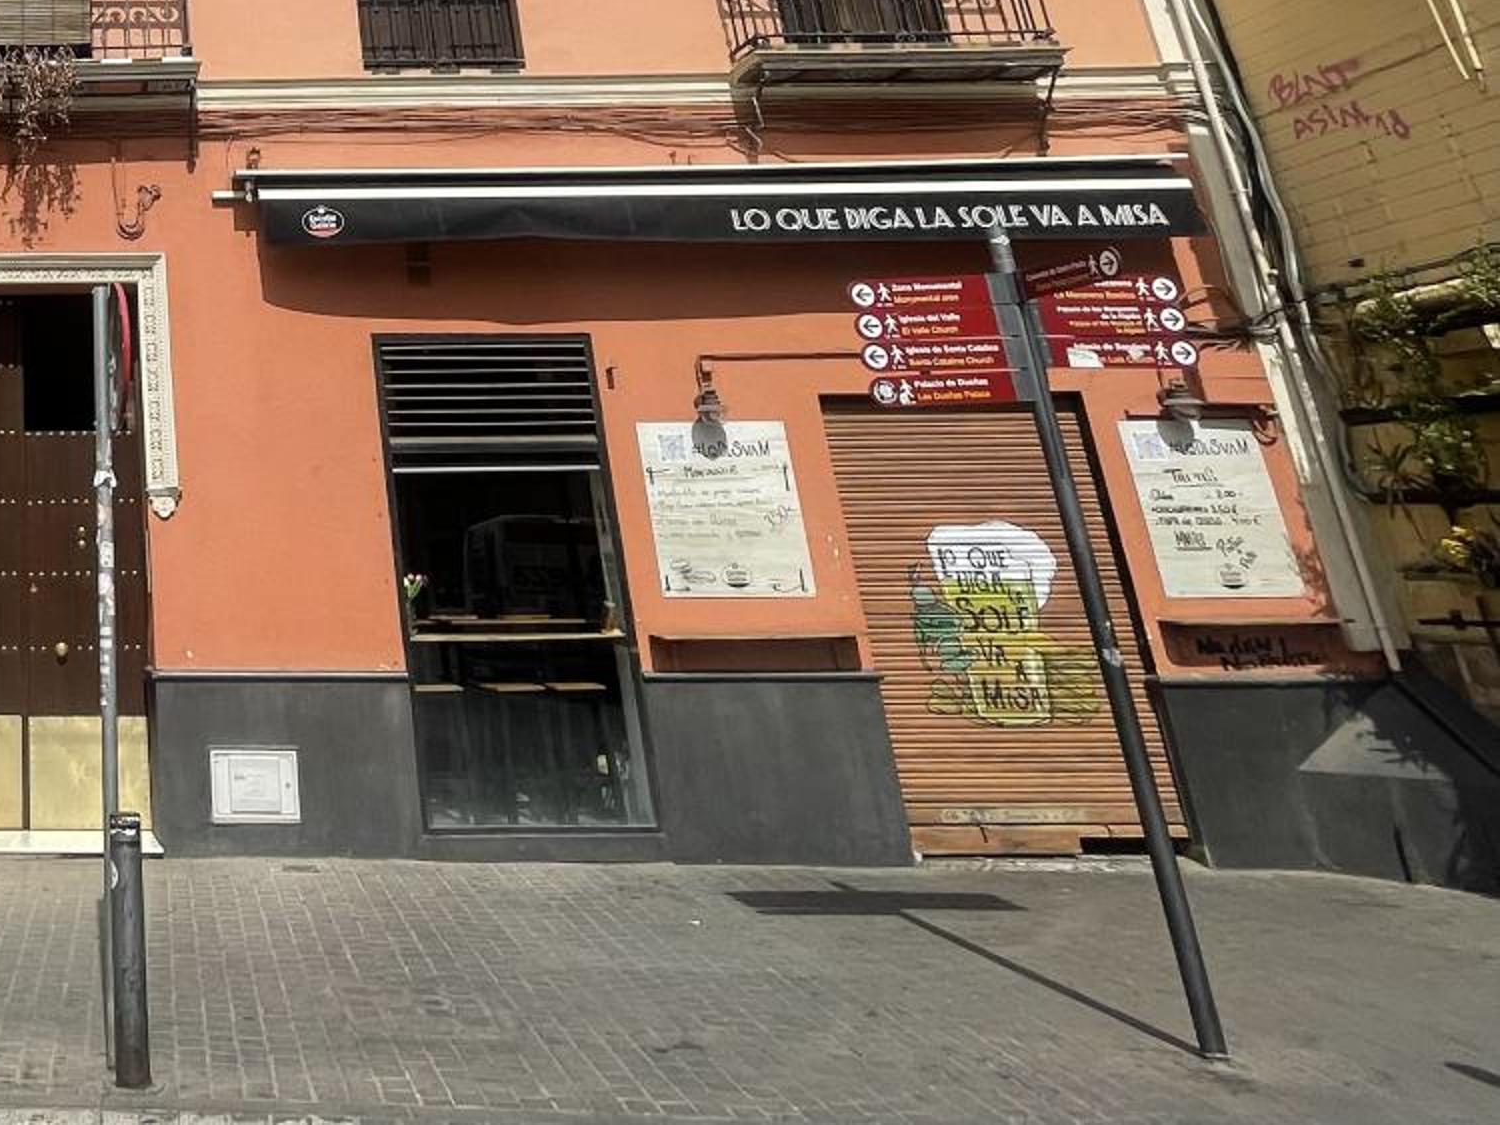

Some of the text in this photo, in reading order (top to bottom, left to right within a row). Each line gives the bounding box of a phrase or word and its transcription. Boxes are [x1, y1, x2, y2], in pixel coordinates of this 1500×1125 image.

[730, 202, 1170, 232] LO QUE DIGA LA SOLE VA A MISA
[967, 546, 1012, 570] QUE
